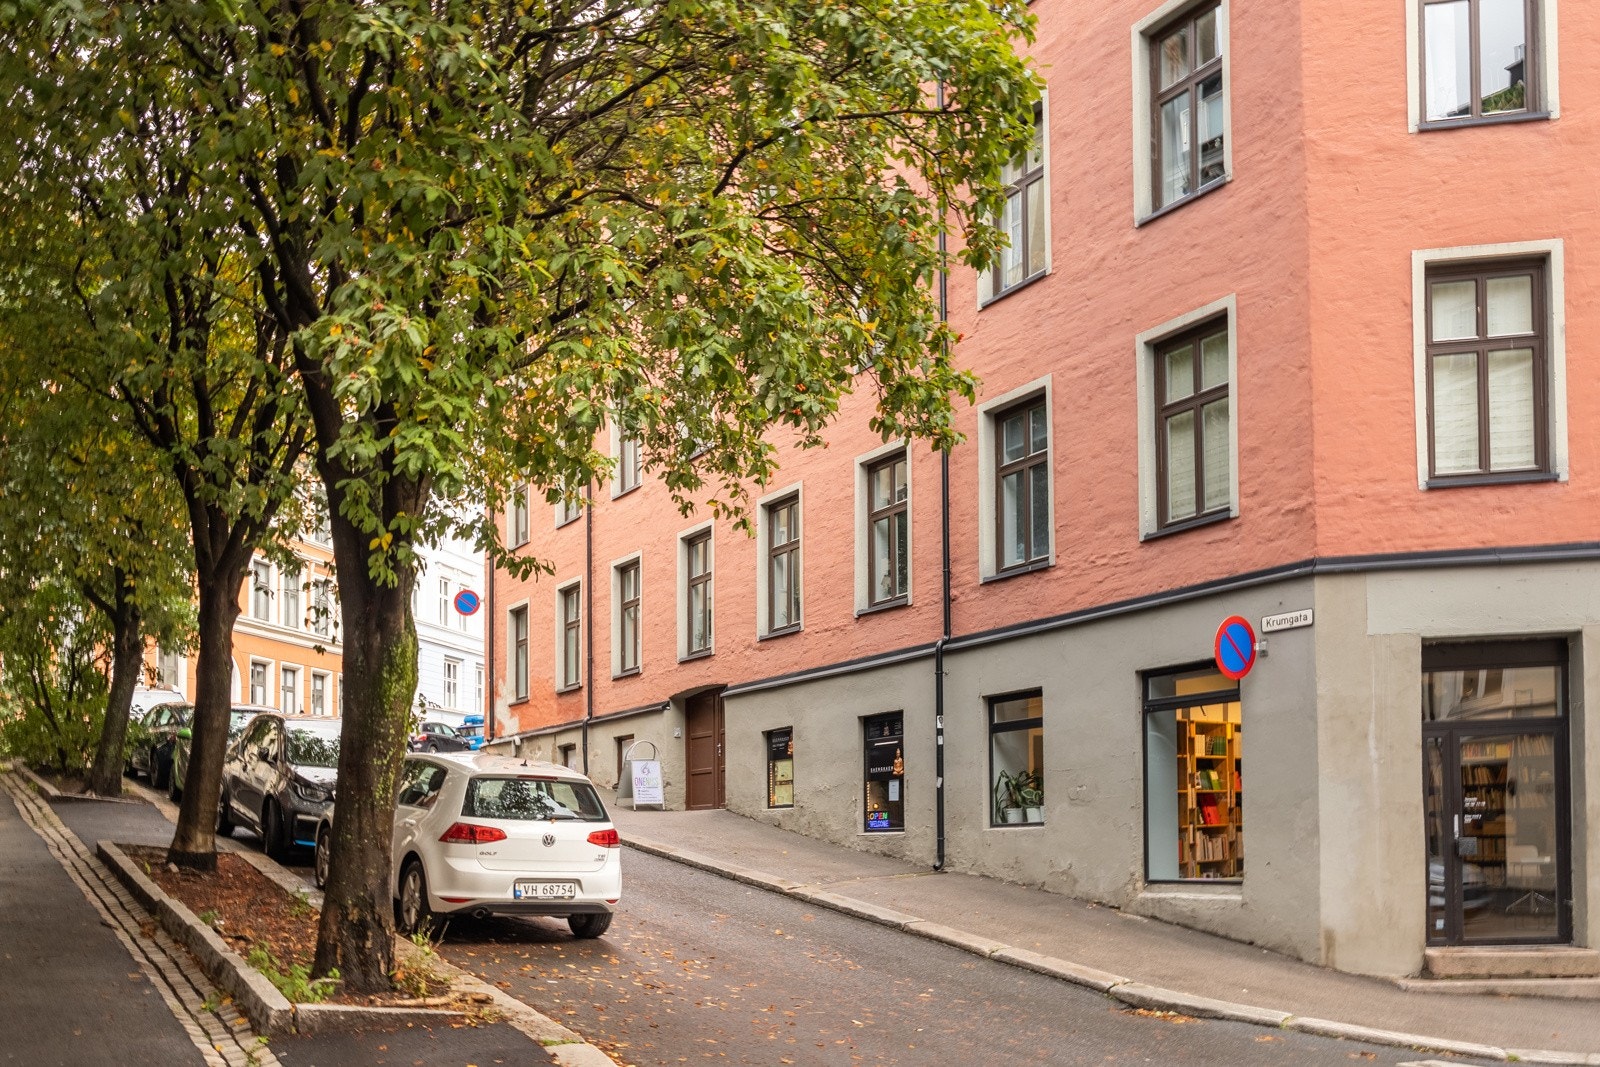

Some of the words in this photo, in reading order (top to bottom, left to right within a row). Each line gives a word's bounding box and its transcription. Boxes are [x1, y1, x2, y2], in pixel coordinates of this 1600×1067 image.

[1265, 612, 1308, 628] Krumgata
[869, 811, 888, 820] OPEN
[523, 884, 538, 895] VH
[542, 884, 573, 895] 68754
